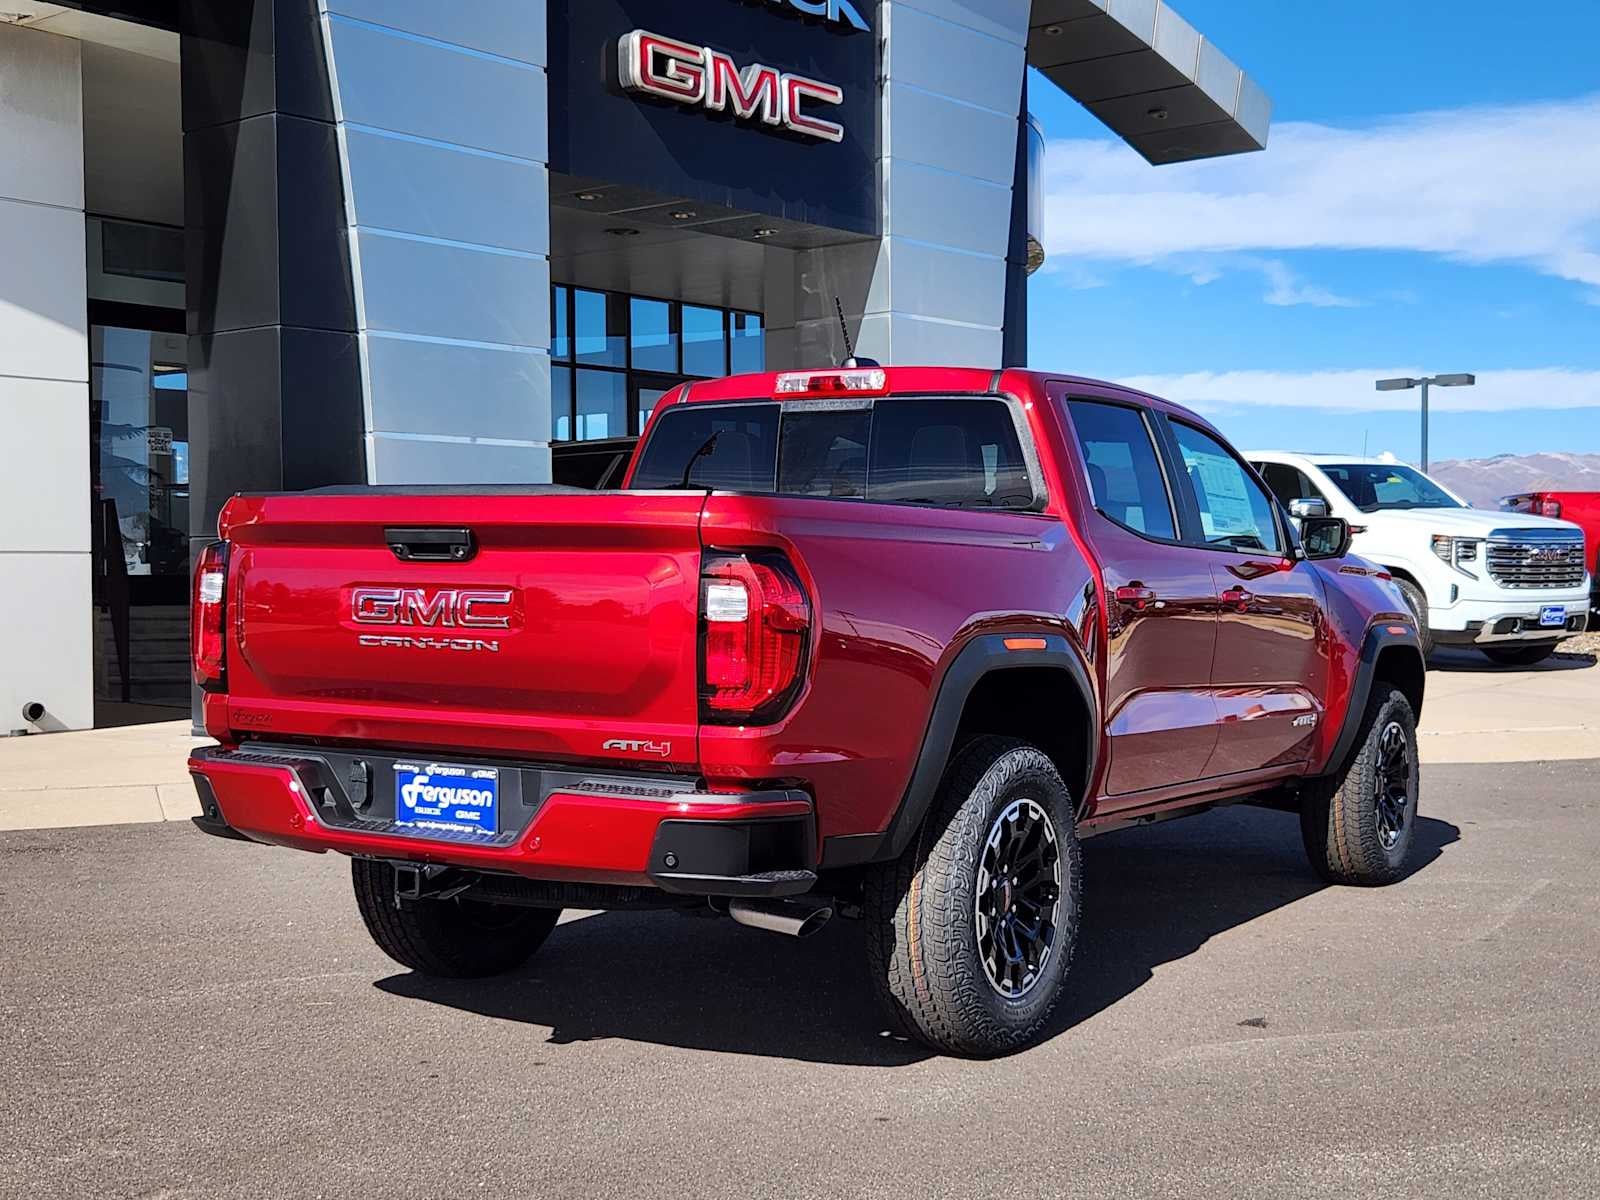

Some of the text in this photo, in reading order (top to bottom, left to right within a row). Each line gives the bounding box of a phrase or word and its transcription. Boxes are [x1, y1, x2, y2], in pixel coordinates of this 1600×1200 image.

[619, 29, 844, 143] GMC
[352, 587, 513, 628] GMC
[358, 635, 499, 652] CANYON
[602, 739, 671, 757] AT4
[425, 763, 465, 775] Ferguson
[401, 775, 493, 808] Ferguson
[414, 806, 480, 820] BUICK GMC
